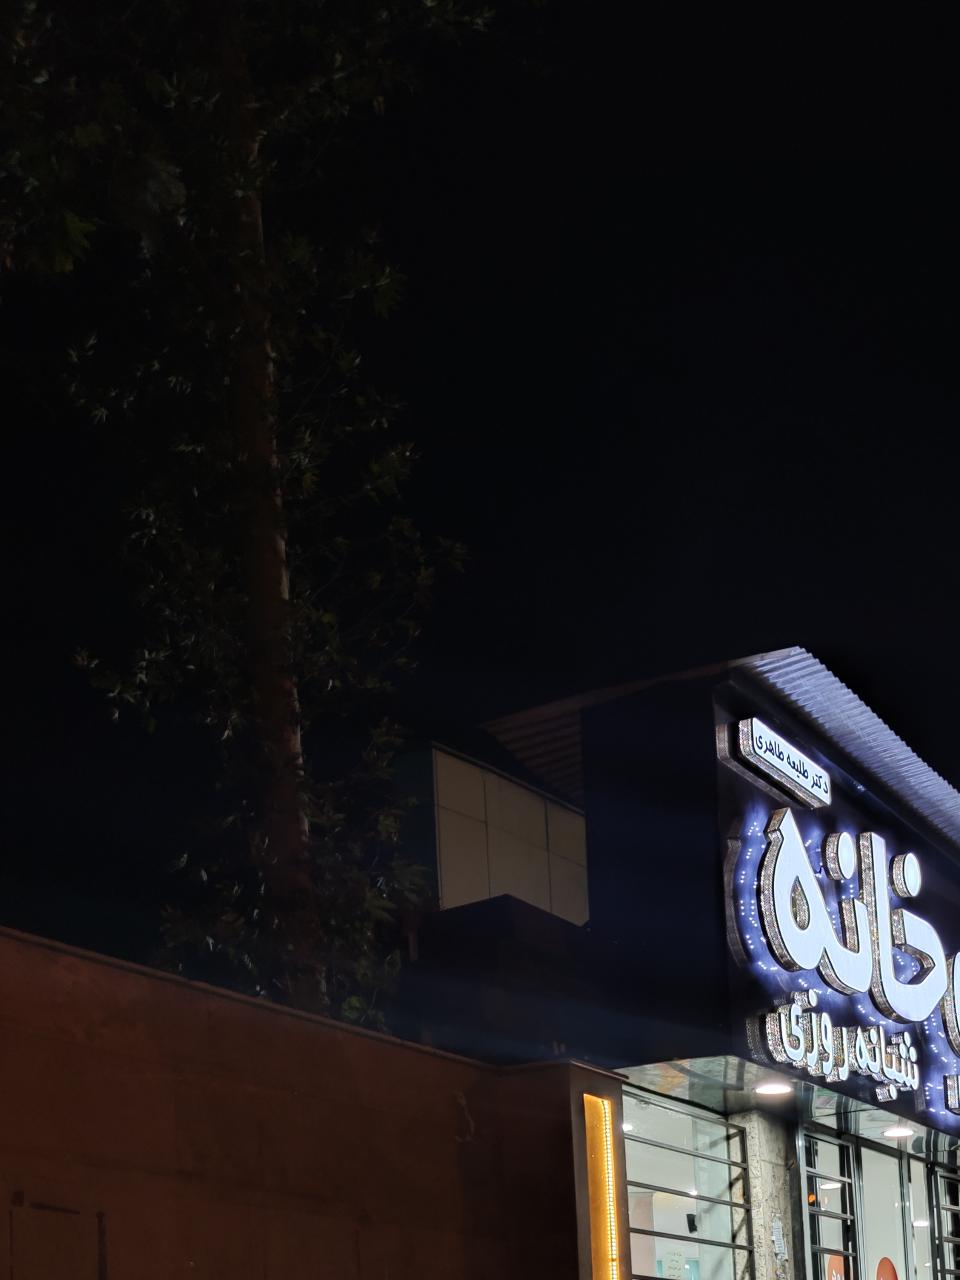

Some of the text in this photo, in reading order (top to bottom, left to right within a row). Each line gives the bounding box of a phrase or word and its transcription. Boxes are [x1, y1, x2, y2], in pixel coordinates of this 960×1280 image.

[755, 735, 829, 794] دکتر طلیعه طاهری
[774, 988, 920, 1100] شبانه روزی
